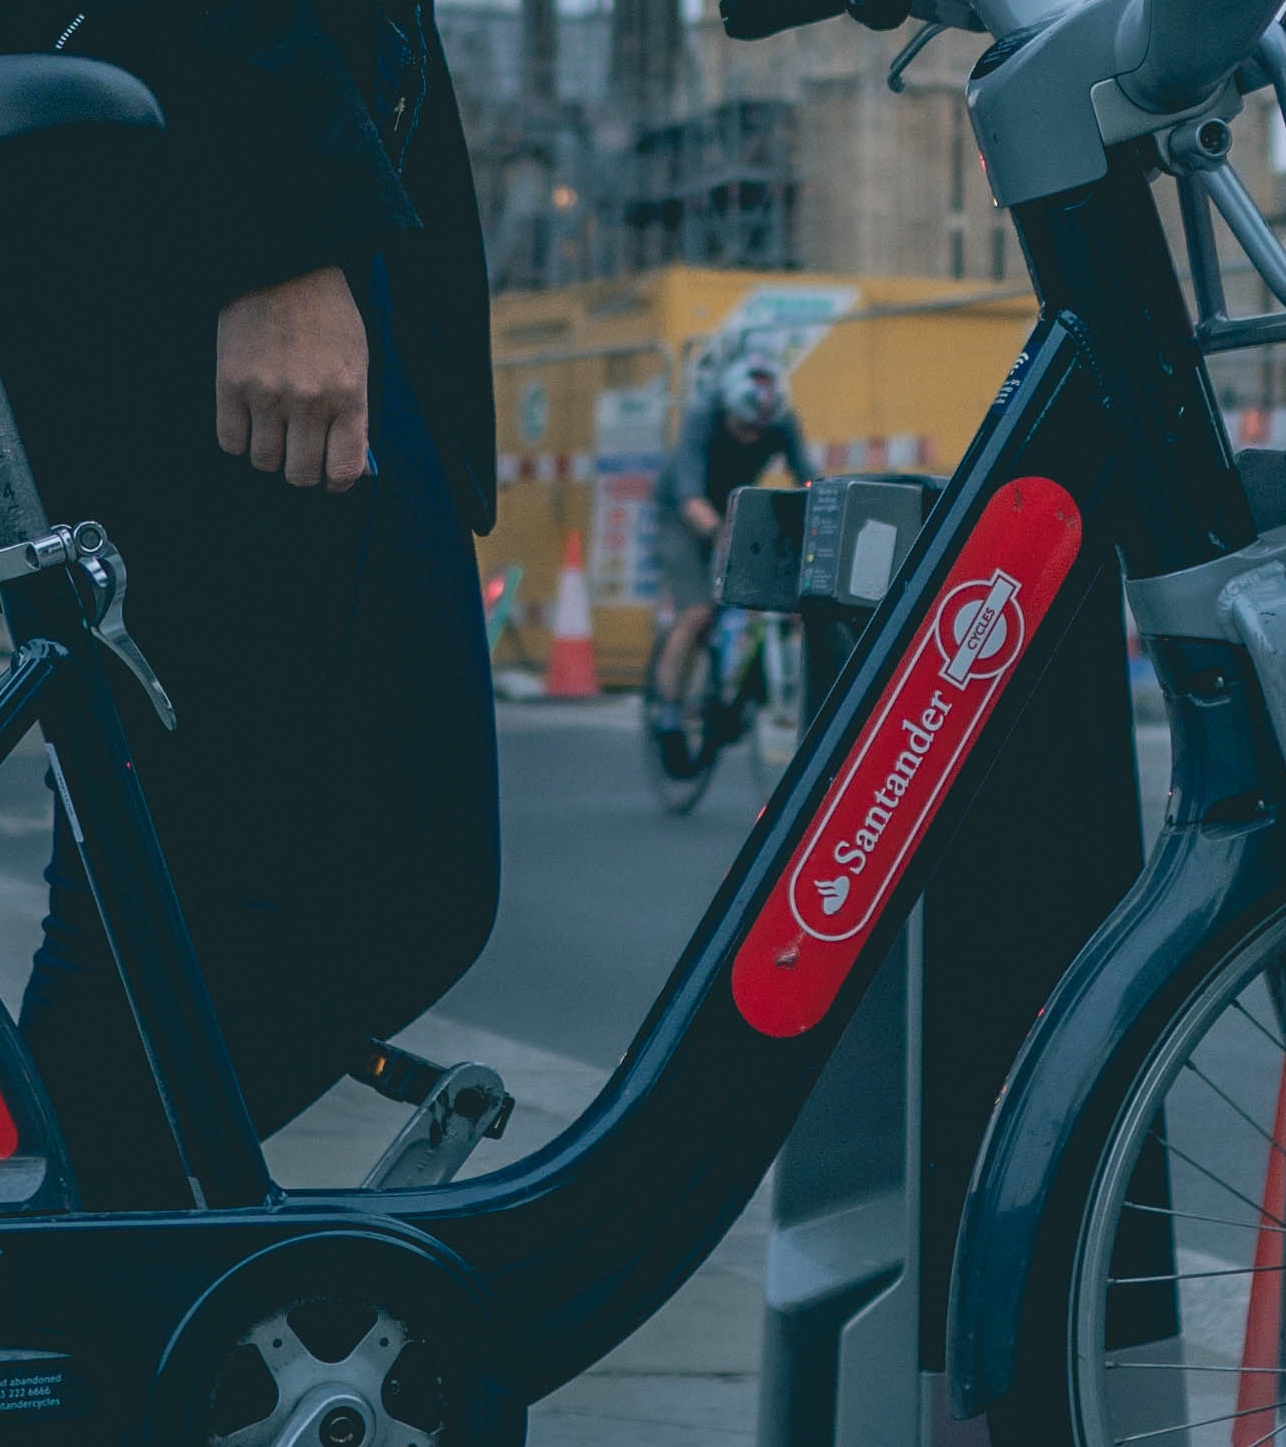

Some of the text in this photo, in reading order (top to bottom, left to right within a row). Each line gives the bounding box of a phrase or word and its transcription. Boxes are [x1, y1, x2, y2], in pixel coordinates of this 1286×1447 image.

[968, 606, 995, 651] CYCLES
[834, 689, 953, 875] Santander
[9, 1373, 62, 1387] abandoned
[9, 1388, 26, 1399] 222
[27, 1385, 51, 1397] 6666
